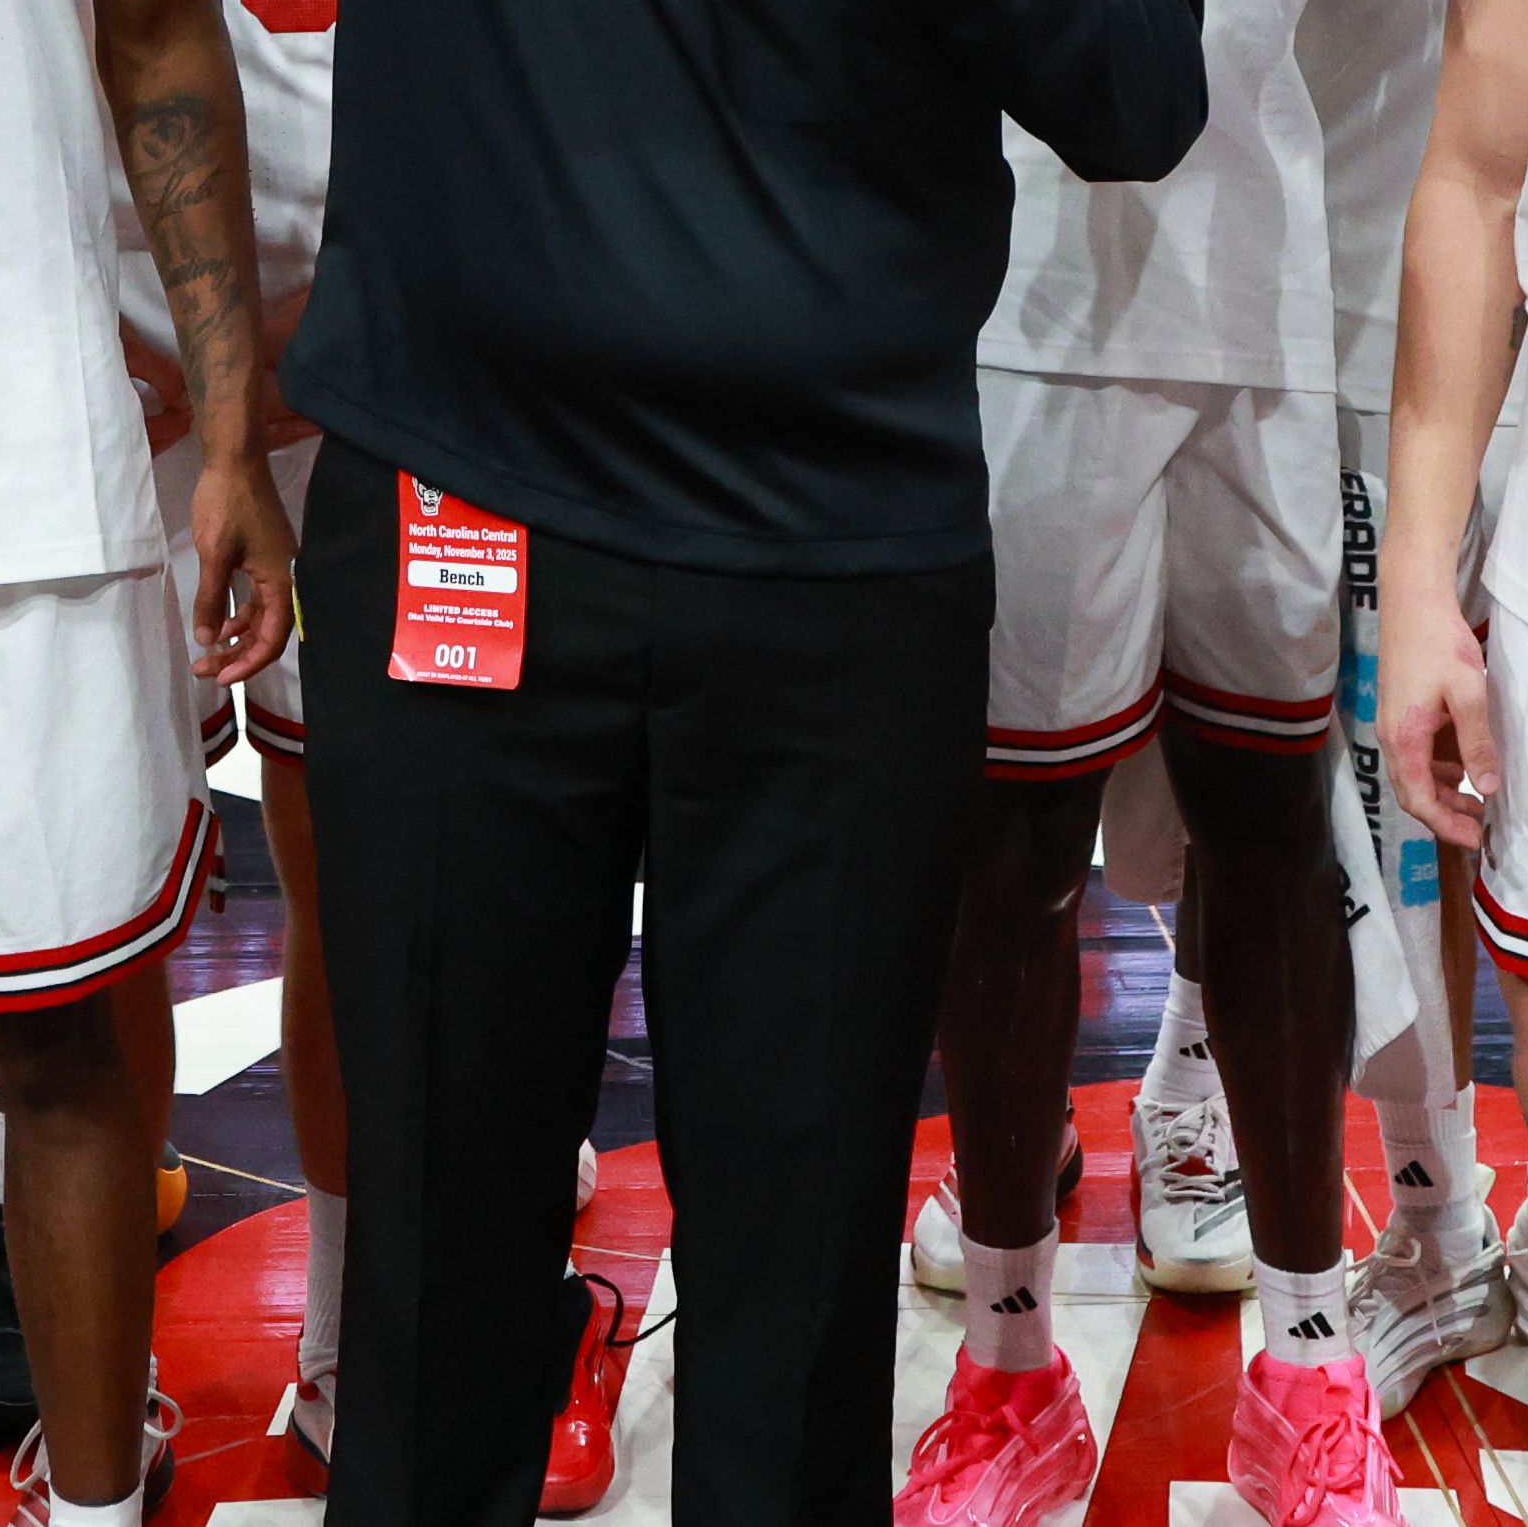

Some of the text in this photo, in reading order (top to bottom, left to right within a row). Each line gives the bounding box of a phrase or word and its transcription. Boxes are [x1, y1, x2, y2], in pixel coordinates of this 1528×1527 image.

[408, 523, 518, 543] North Carolina Central
[408, 542, 518, 562] Monday, November 3, 2025
[439, 568, 485, 586] Bench
[423, 603, 499, 618] LIMITED ACCESS
[434, 643, 477, 670] 001
